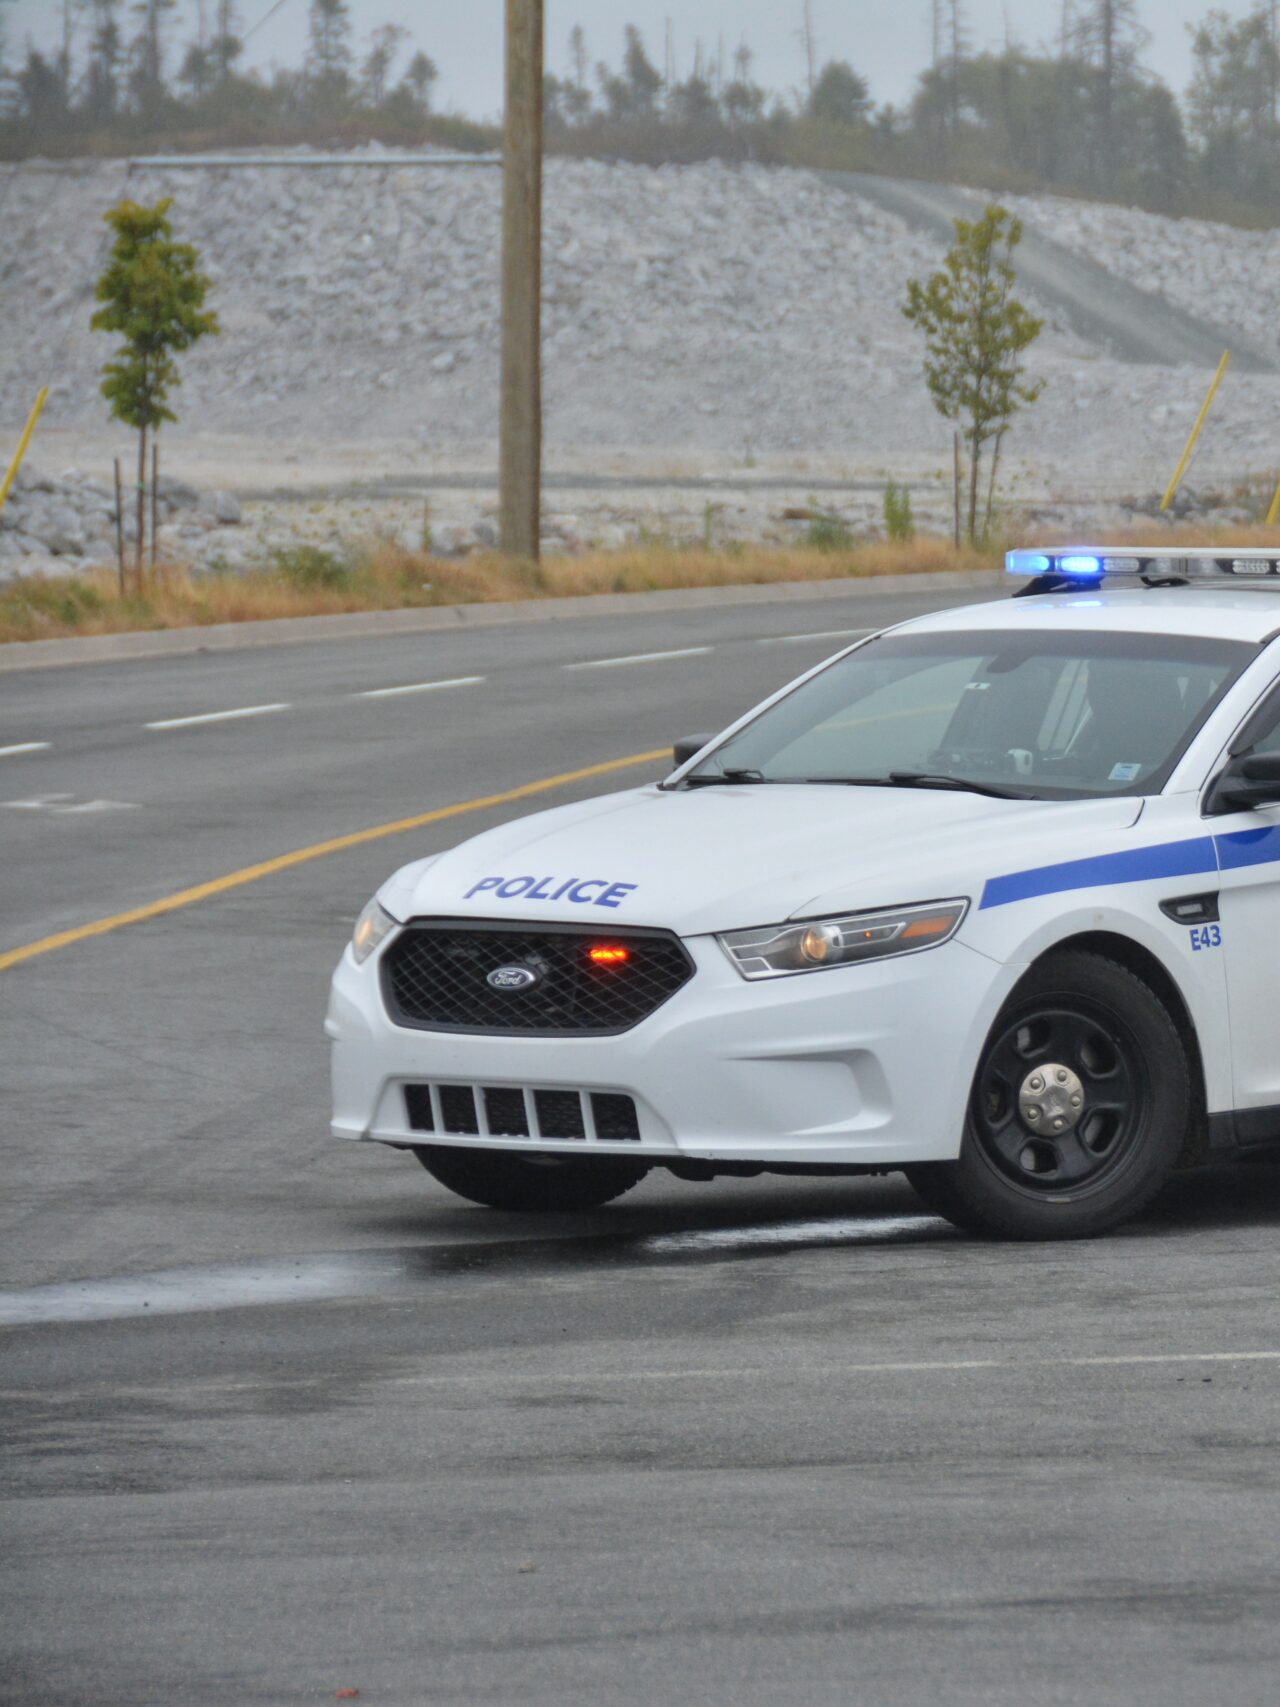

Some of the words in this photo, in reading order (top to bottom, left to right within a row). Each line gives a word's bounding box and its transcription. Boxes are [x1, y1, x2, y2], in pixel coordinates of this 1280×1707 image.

[462, 876, 638, 908] POLICE
[1189, 925, 1221, 951] E43
[495, 971, 522, 985] Ford
